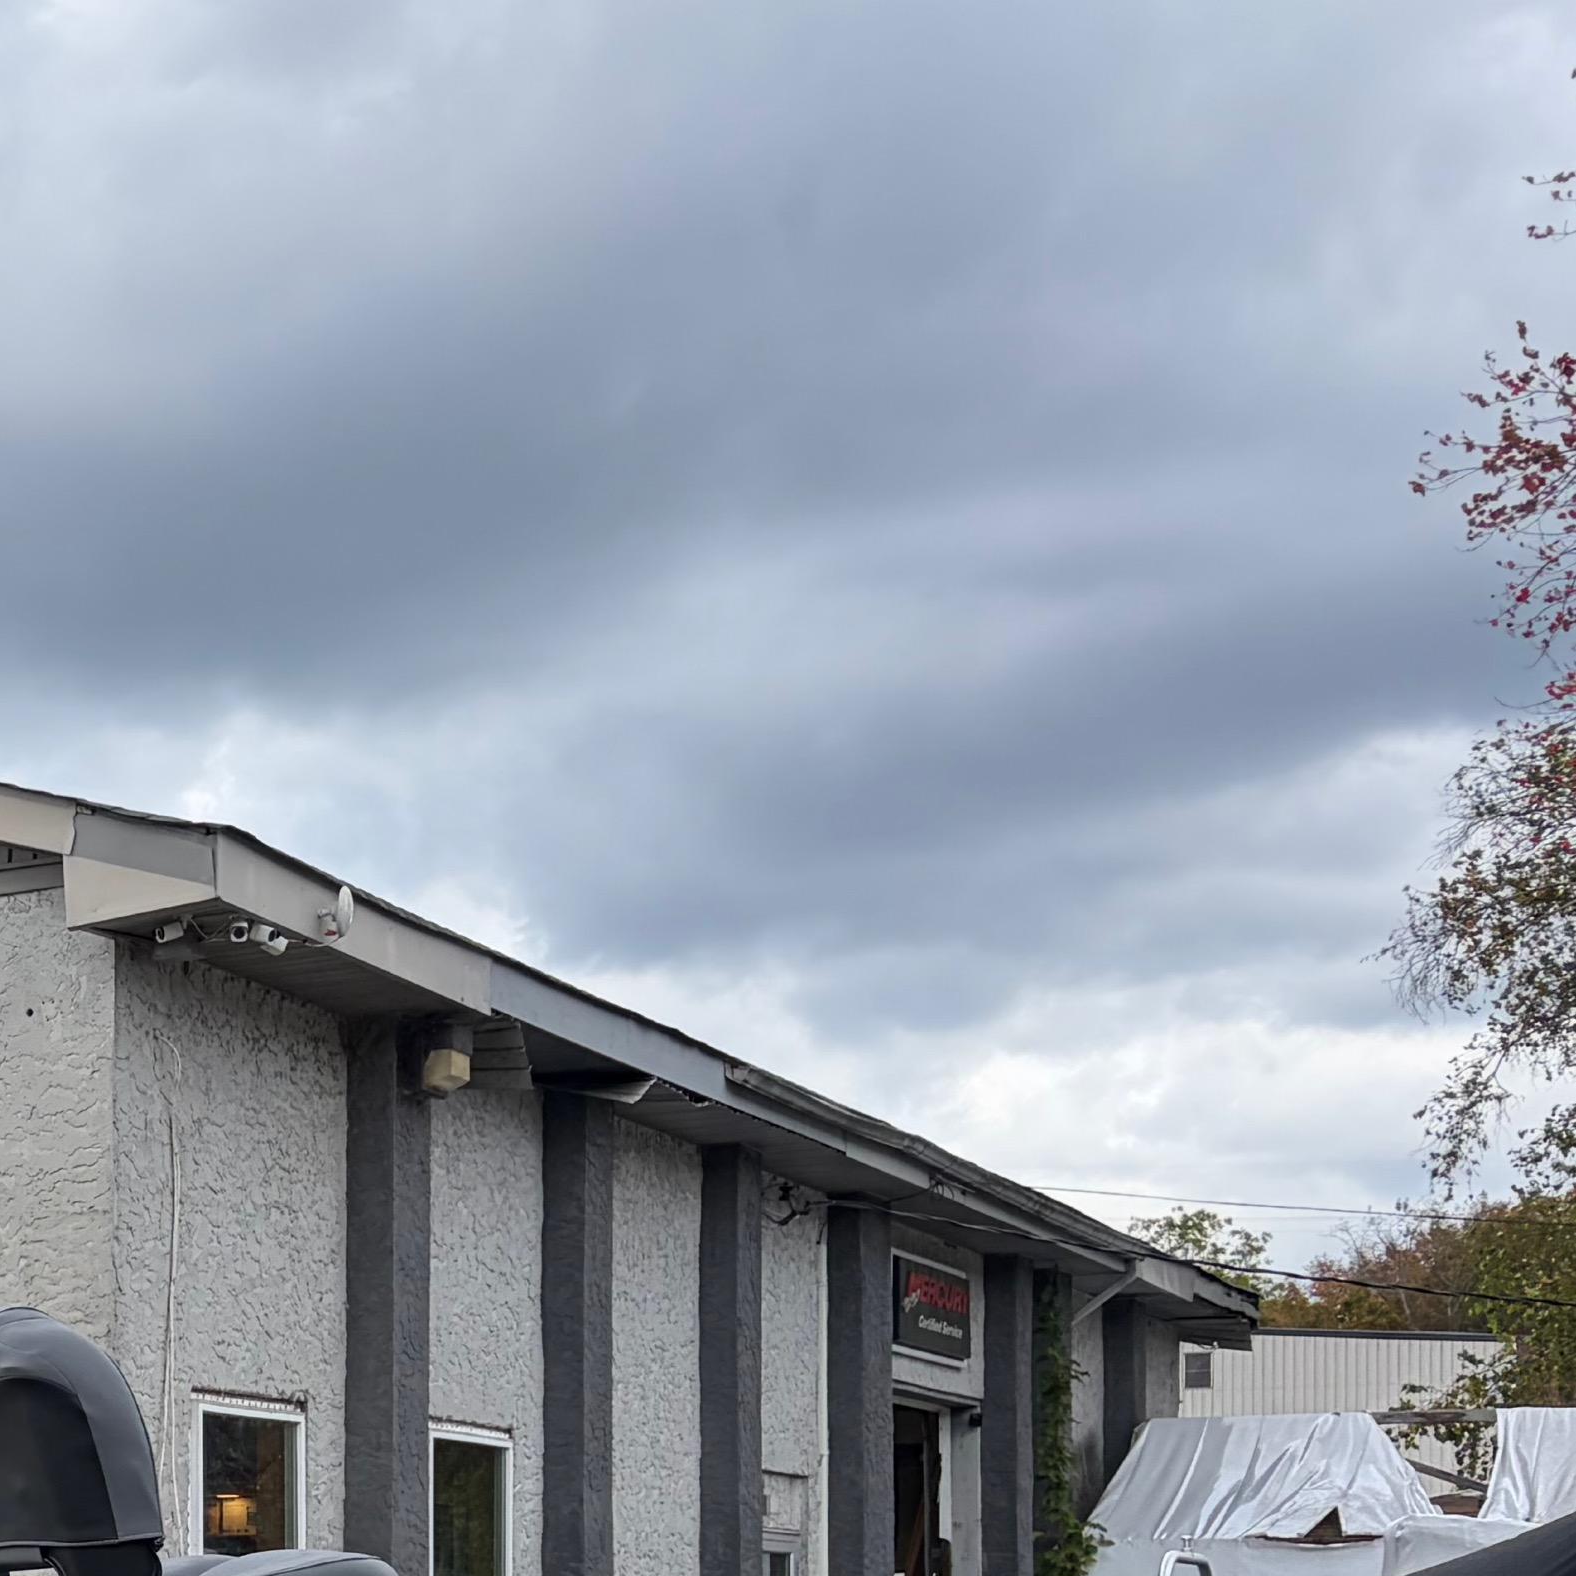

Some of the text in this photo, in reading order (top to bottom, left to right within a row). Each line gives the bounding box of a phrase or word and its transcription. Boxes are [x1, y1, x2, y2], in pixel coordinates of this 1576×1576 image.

[908, 1272, 969, 1315] MERCURY
[919, 1315, 963, 1339] Certified Service
